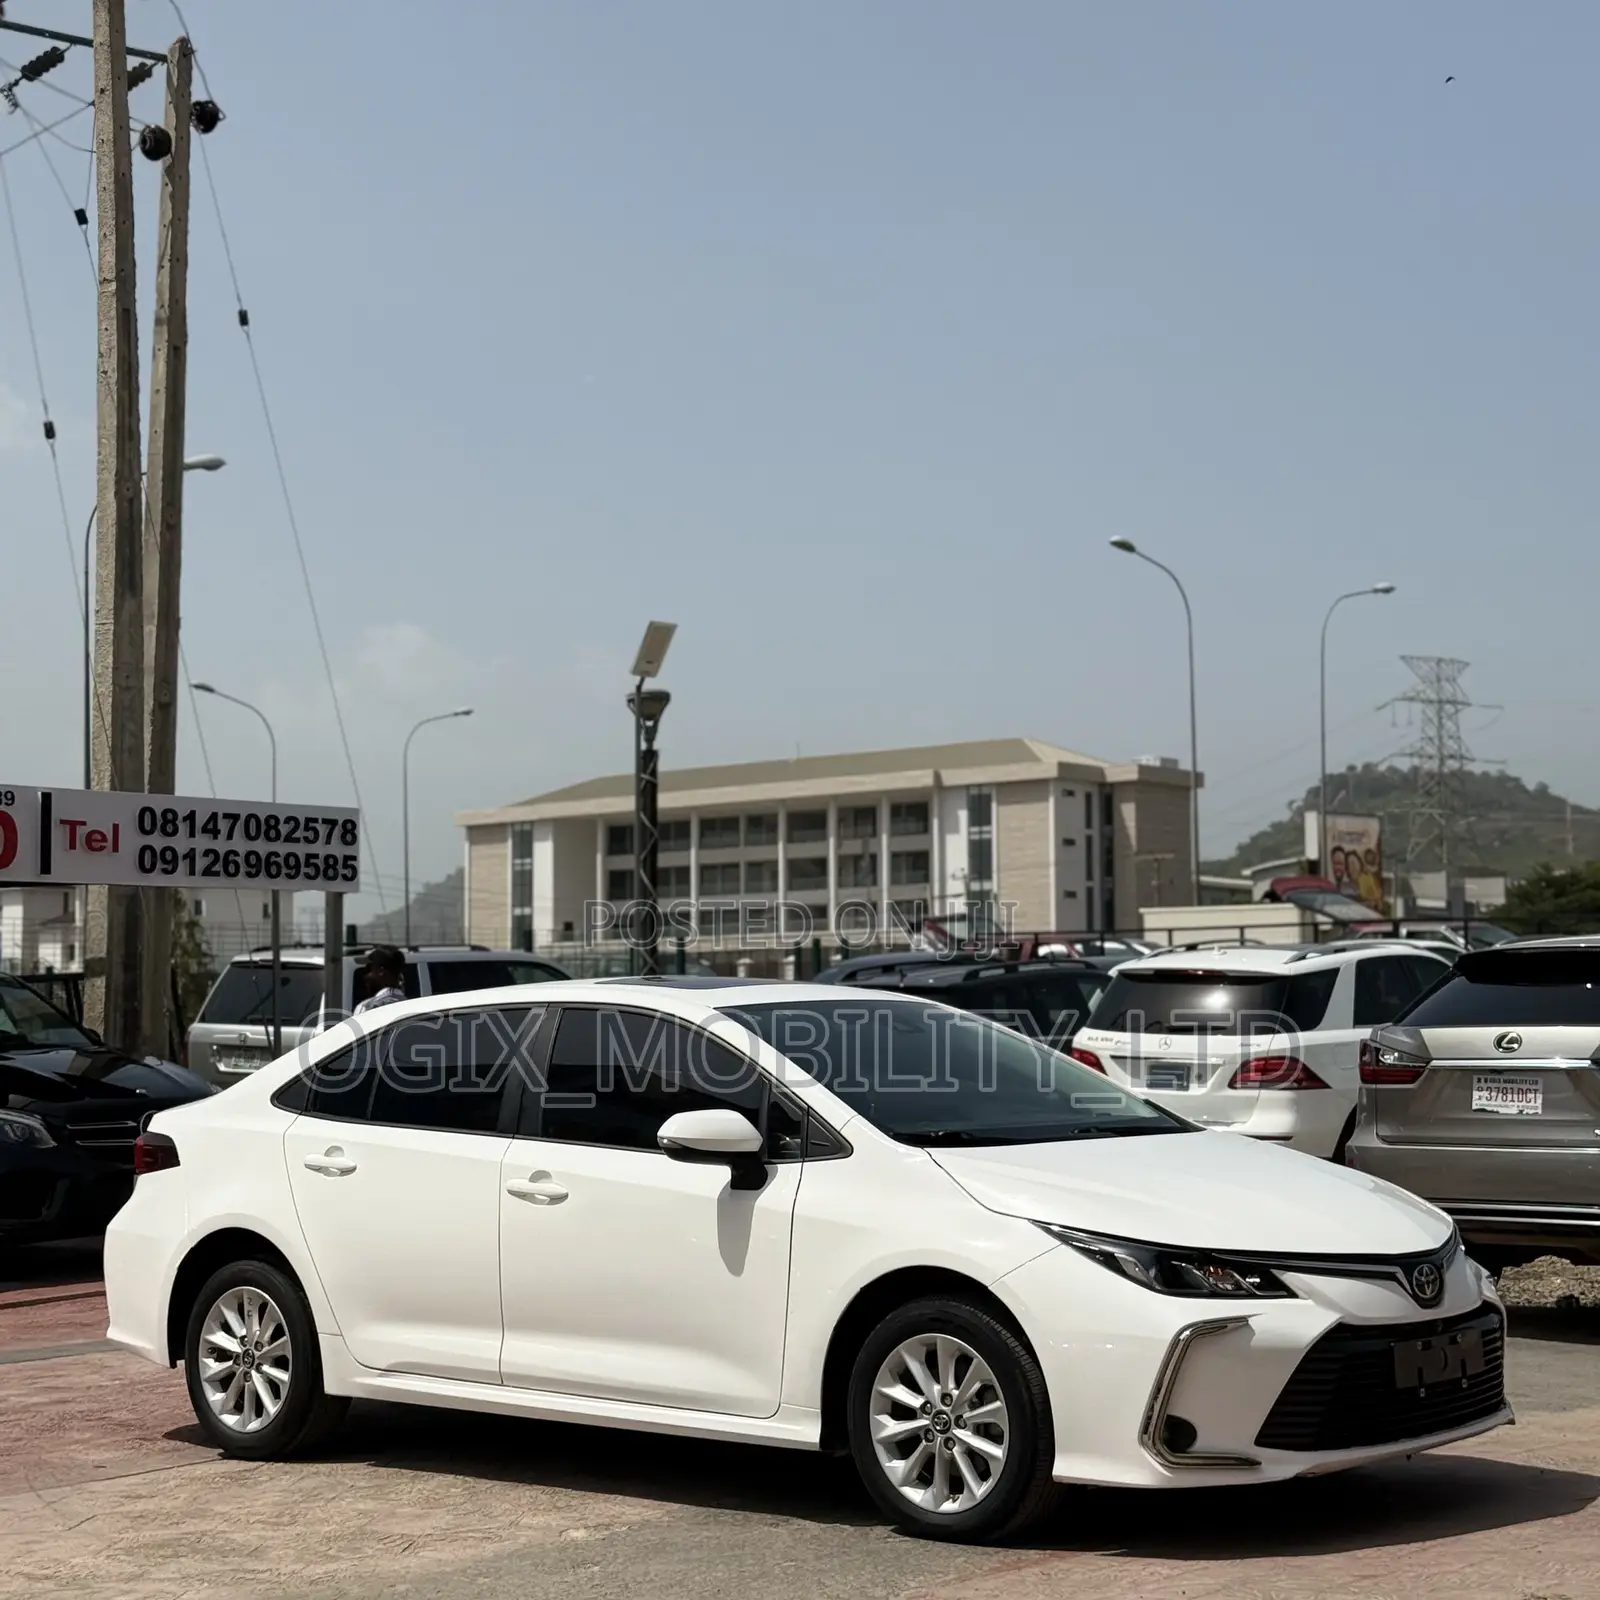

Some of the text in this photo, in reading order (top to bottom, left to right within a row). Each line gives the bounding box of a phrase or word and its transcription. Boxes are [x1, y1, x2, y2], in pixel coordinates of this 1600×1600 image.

[60, 818, 120, 853] Tel
[137, 806, 358, 846] 08147082578
[137, 844, 358, 882] 09126969585
[1486, 1086, 1540, 1104] 3781DCT
